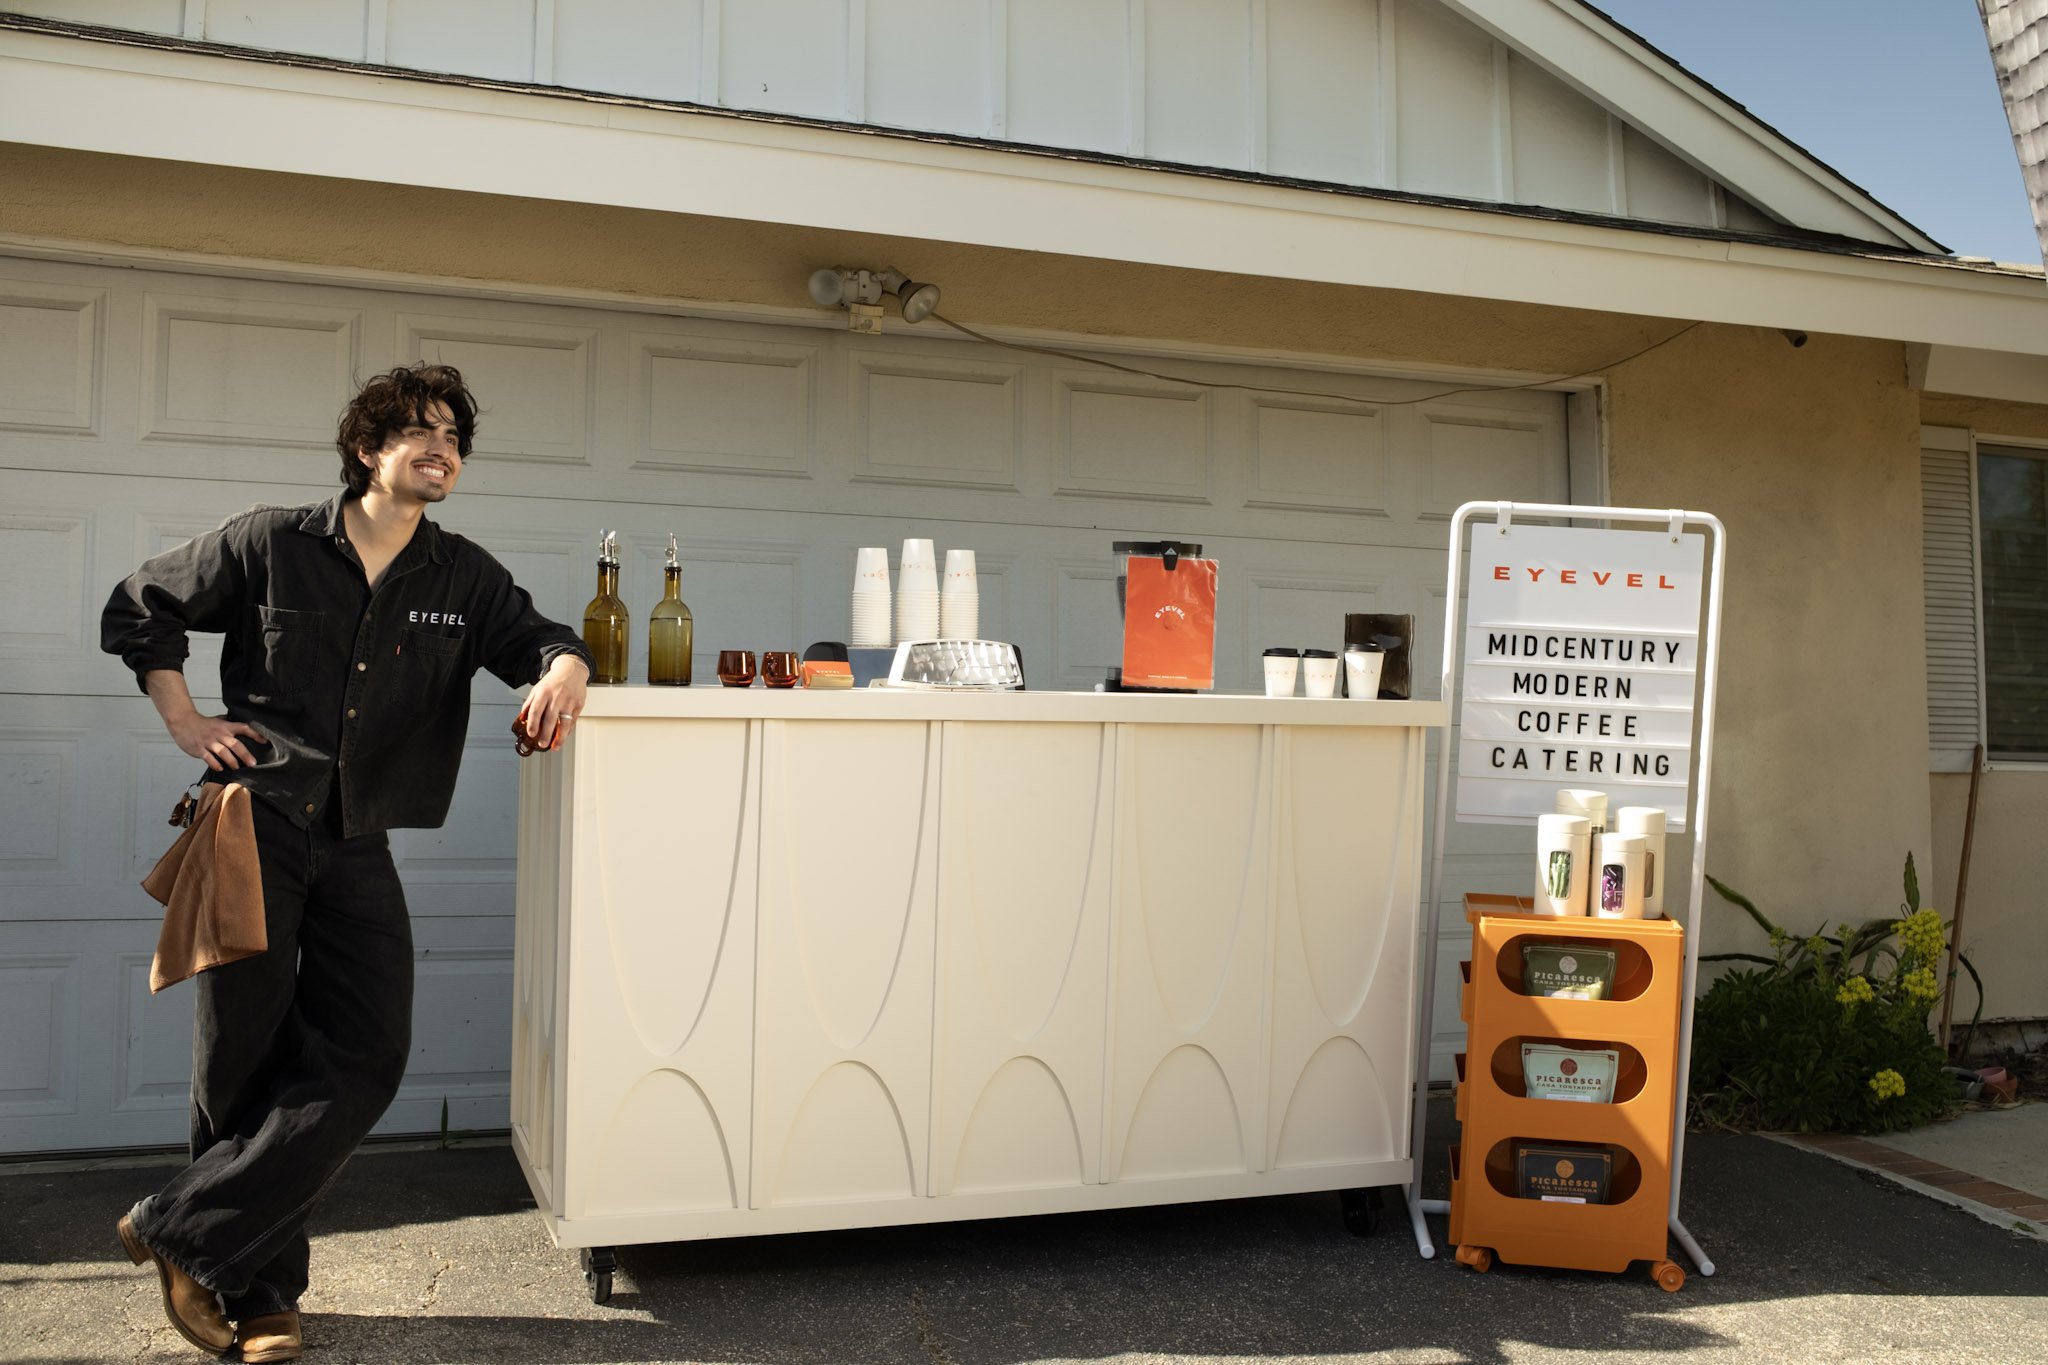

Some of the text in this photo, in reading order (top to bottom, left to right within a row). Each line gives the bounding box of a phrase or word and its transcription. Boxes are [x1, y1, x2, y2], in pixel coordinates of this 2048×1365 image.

[1494, 566, 1675, 589] EYEVEL
[1154, 605, 1186, 621] EYEVEL
[1488, 633, 1680, 663] MIDCENTURY
[1513, 672, 1631, 699] MODERN
[1518, 710, 1637, 737] COFFEE
[1492, 747, 1670, 776] CATERING
